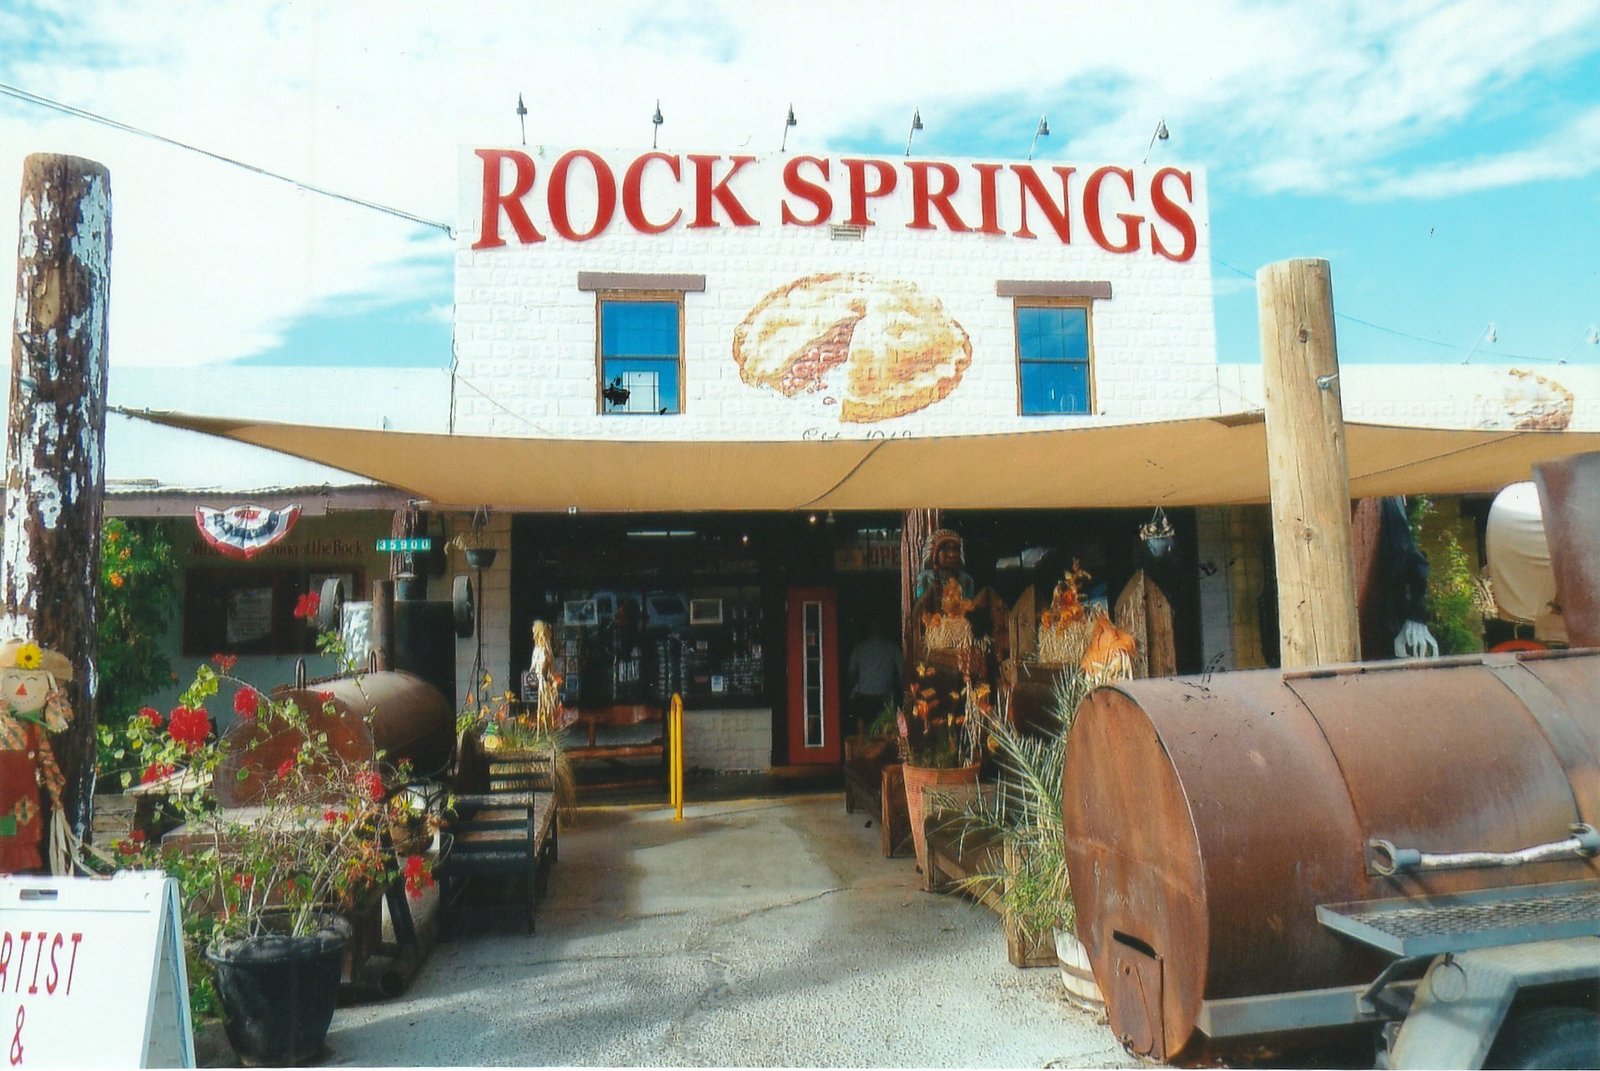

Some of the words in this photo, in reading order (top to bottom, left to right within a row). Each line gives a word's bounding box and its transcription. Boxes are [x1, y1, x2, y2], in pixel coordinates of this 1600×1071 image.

[471, 149, 760, 250] ROCK
[781, 155, 1198, 263] SPRINGS
[333, 538, 364, 555] Rock
[379, 540, 428, 550] 35900
[10, 1004, 25, 1066] &
